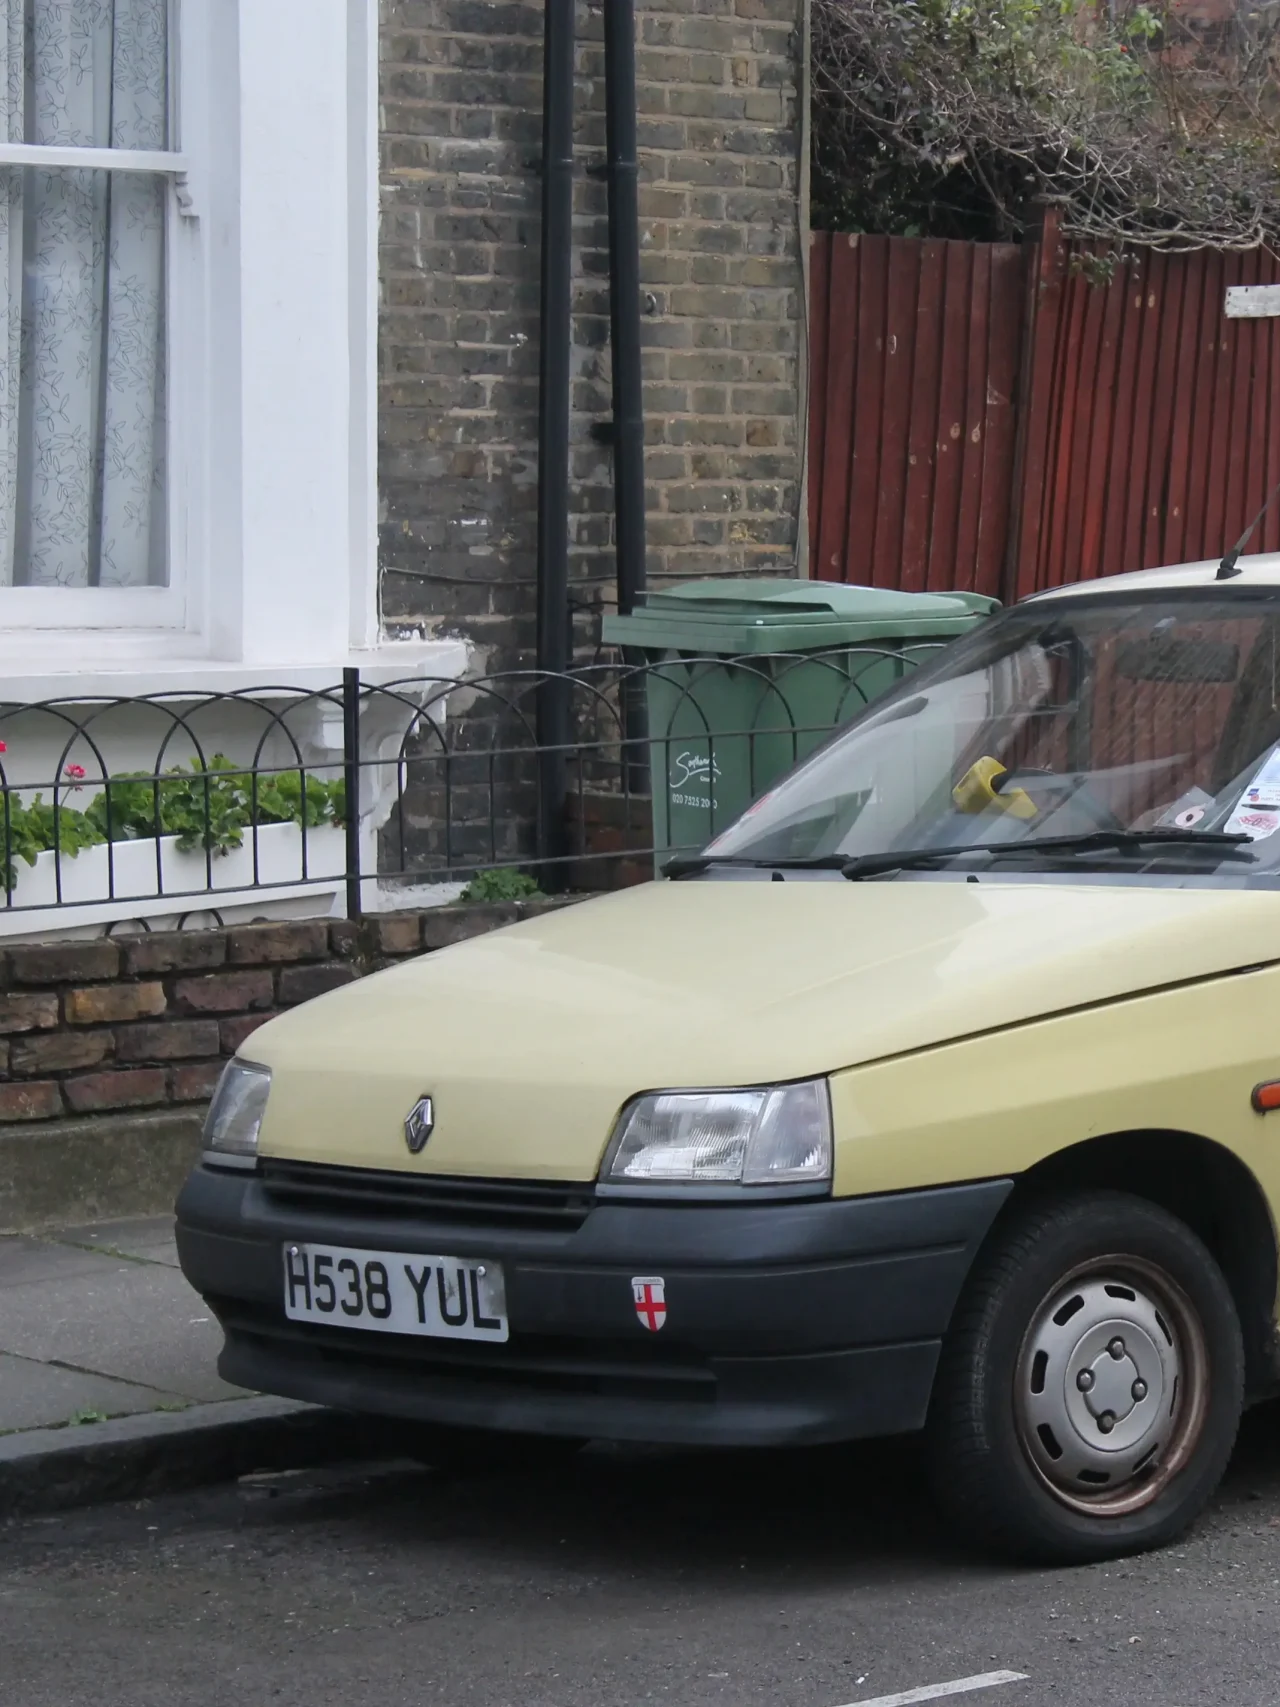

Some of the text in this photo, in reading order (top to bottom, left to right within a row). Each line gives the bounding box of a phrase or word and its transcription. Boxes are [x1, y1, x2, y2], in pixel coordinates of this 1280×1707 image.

[672, 793, 718, 809] 020 7525 200
[286, 1250, 502, 1330] H538 YUL
